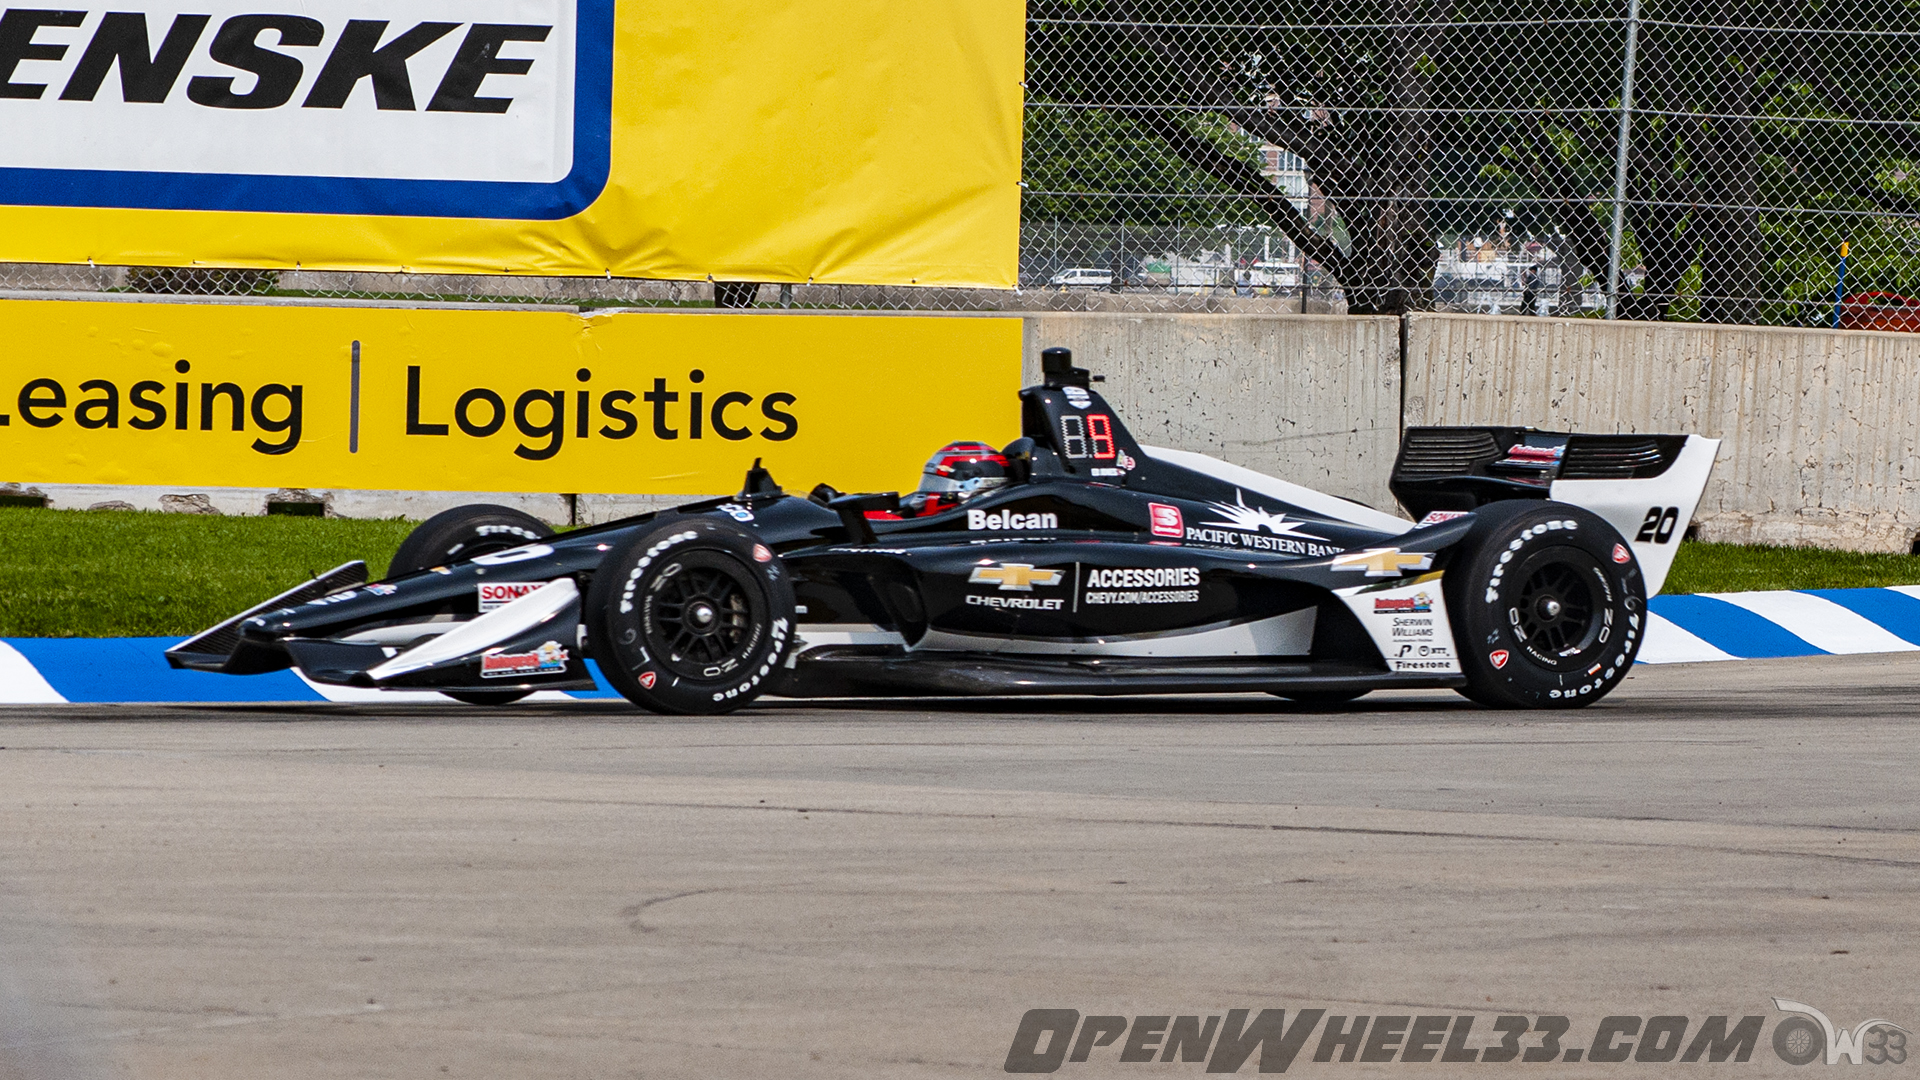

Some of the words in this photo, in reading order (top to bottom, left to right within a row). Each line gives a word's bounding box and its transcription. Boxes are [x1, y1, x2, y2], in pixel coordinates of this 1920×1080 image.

[0, 8, 554, 115] ENSKE
[0, 359, 304, 456] easing
[406, 365, 799, 461] Logistics
[967, 509, 1058, 531] Belcan
[1635, 507, 1680, 544] 20
[1186, 527, 1240, 546] PACIFIC
[1240, 533, 1306, 554] WESTERN
[965, 595, 1065, 611] CHEVROLET
[1087, 567, 1201, 588] ACCESSORIES
[1085, 590, 1200, 605] CHEVY.COM/ACCESSORIES
[1395, 661, 1451, 670] Firestone
[1526, 645, 1559, 666] RACING
[1548, 612, 1640, 698] Firestone
